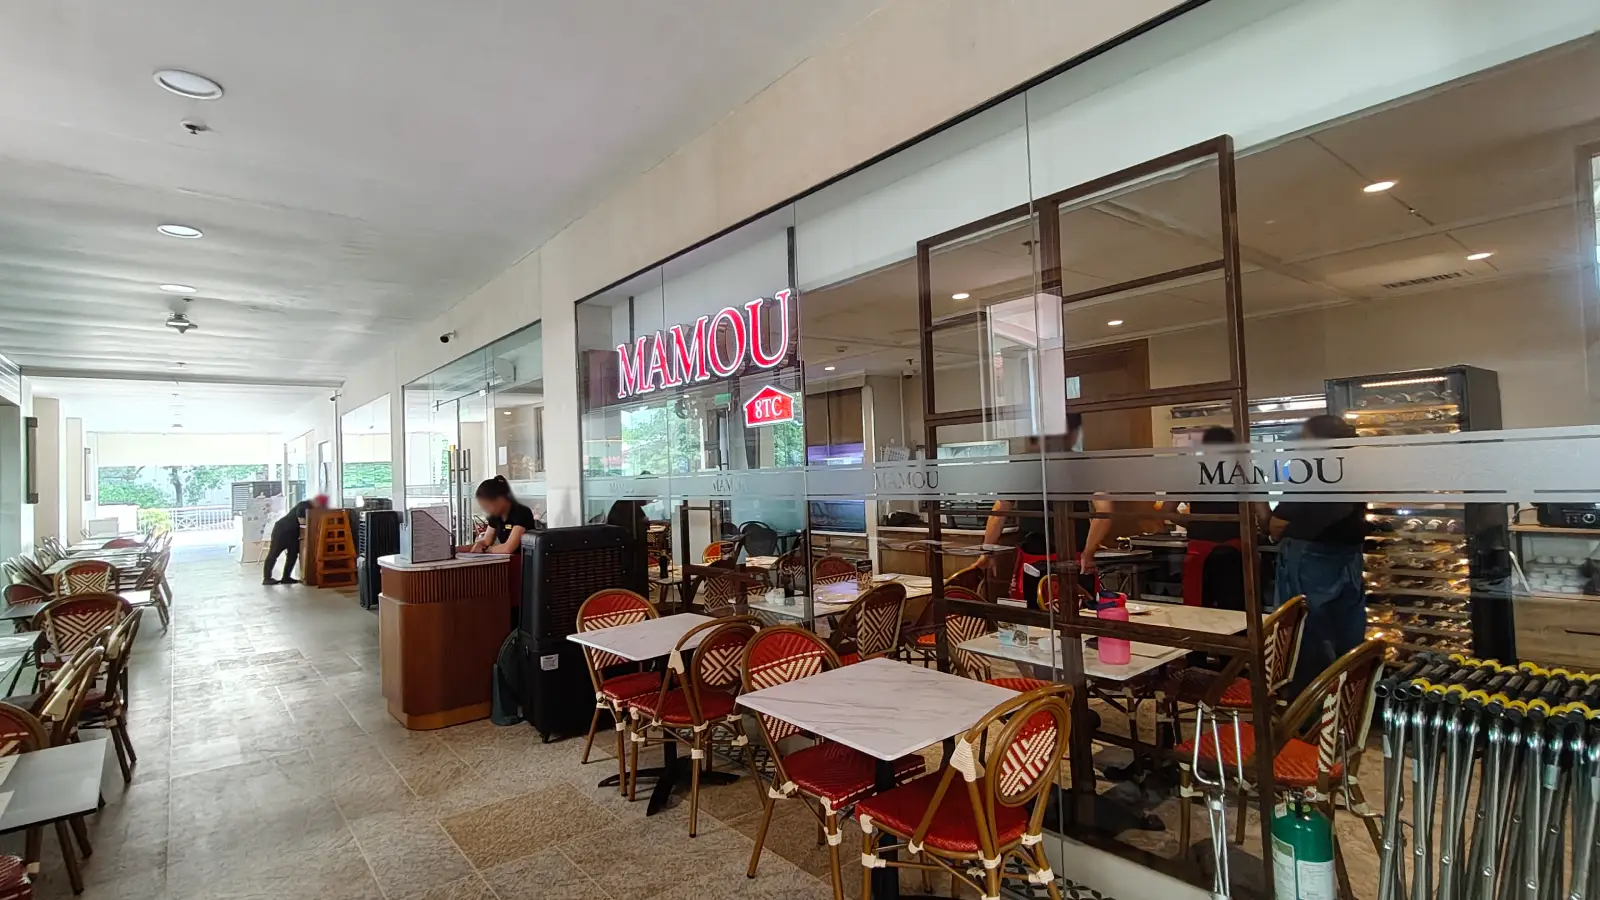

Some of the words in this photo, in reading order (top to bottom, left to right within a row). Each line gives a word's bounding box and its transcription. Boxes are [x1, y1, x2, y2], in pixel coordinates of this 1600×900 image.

[616, 288, 792, 400] MAMOU
[754, 395, 783, 419] 8TC
[1197, 456, 1345, 486] MAMOU
